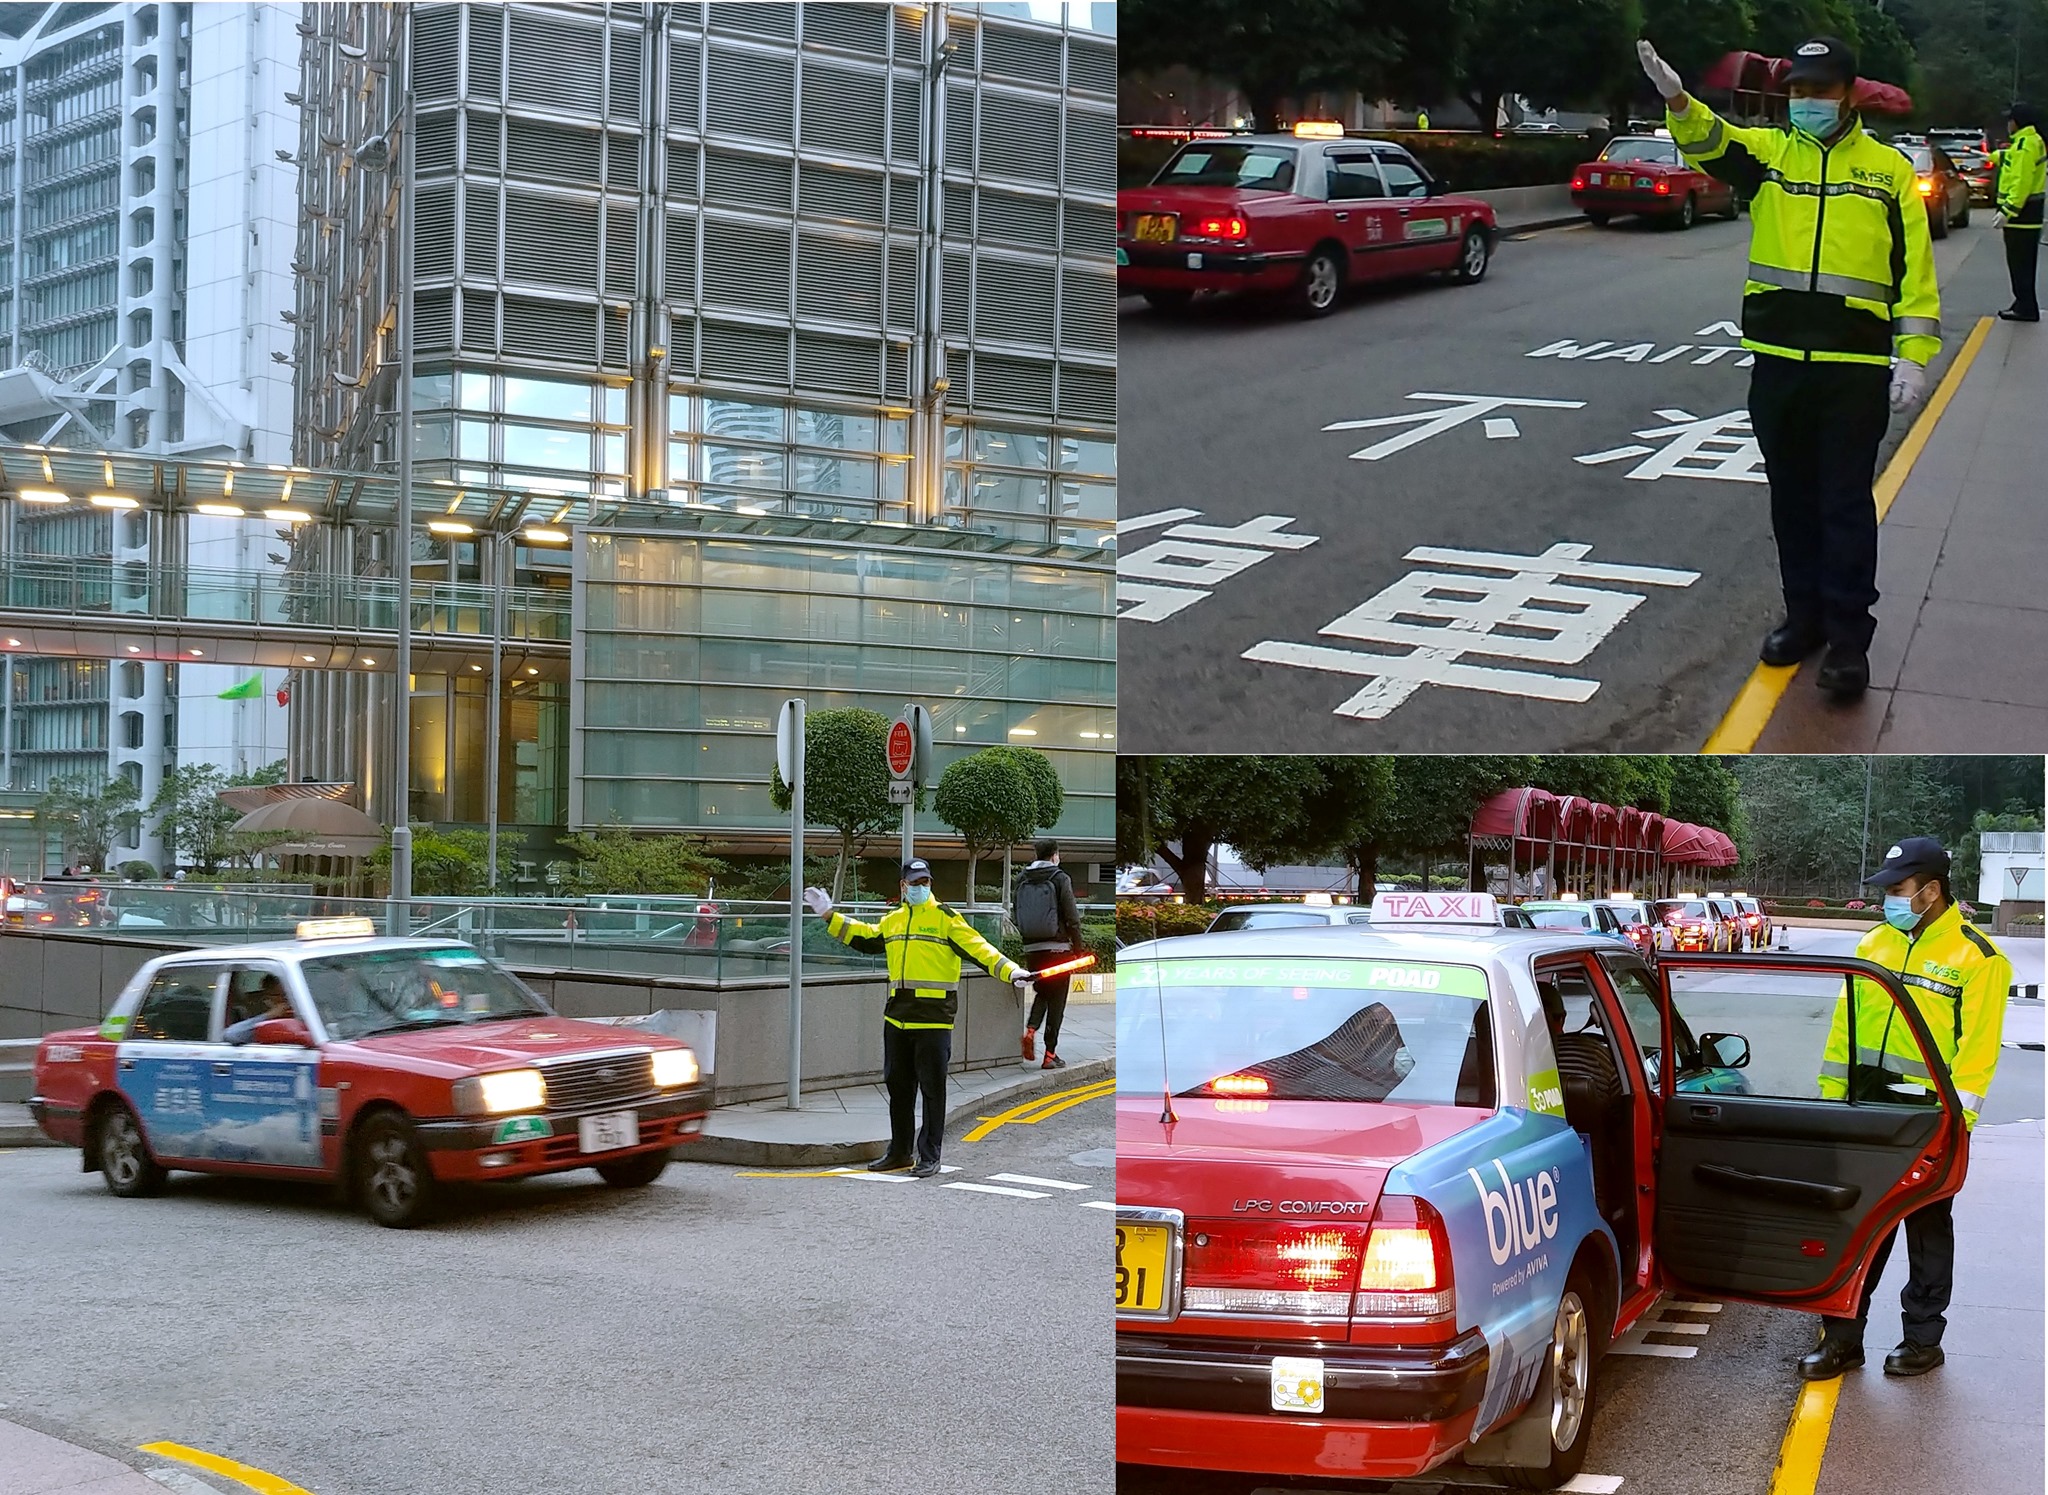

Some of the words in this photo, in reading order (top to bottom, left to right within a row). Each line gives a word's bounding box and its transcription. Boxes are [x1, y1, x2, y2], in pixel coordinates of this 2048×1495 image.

[1383, 896, 1481, 918] TAXI
[1173, 967, 1236, 980] YEARS
[1243, 966, 1272, 980] OF
[1278, 967, 1351, 981] SEEING
[1368, 967, 1441, 989] POAD
[1233, 1199, 1273, 1213] LPG
[1279, 1200, 1369, 1215] COMFORT
[1492, 1270, 1517, 1298] Powered
[1526, 1254, 1549, 1279] AVIVA
